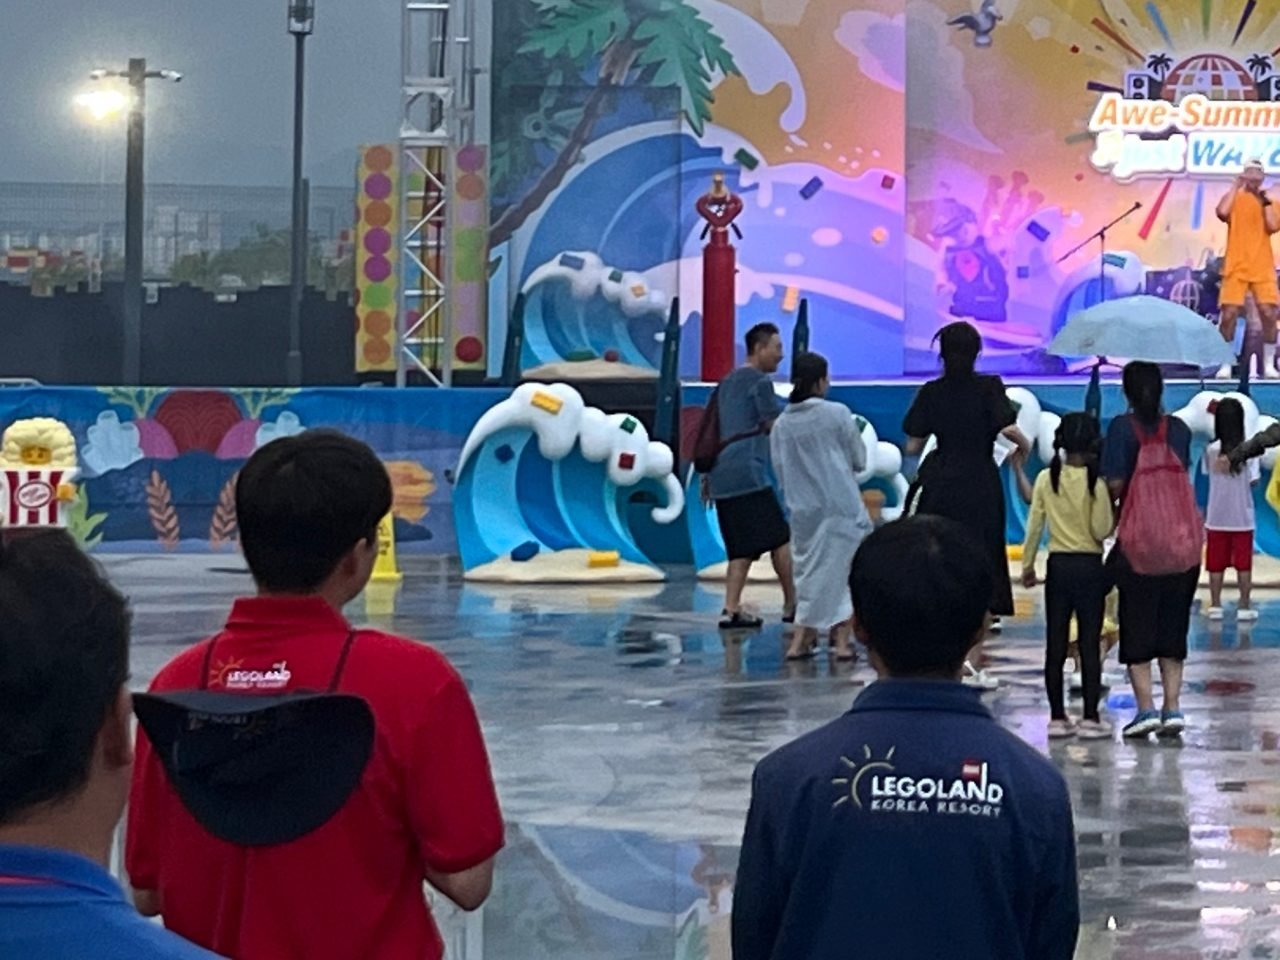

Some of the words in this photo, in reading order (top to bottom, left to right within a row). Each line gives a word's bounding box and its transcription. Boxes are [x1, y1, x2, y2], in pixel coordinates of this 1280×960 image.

[870, 761, 1004, 804] LEGOLAND
[870, 798, 929, 813] KOREA
[936, 801, 1001, 818] RESORT
